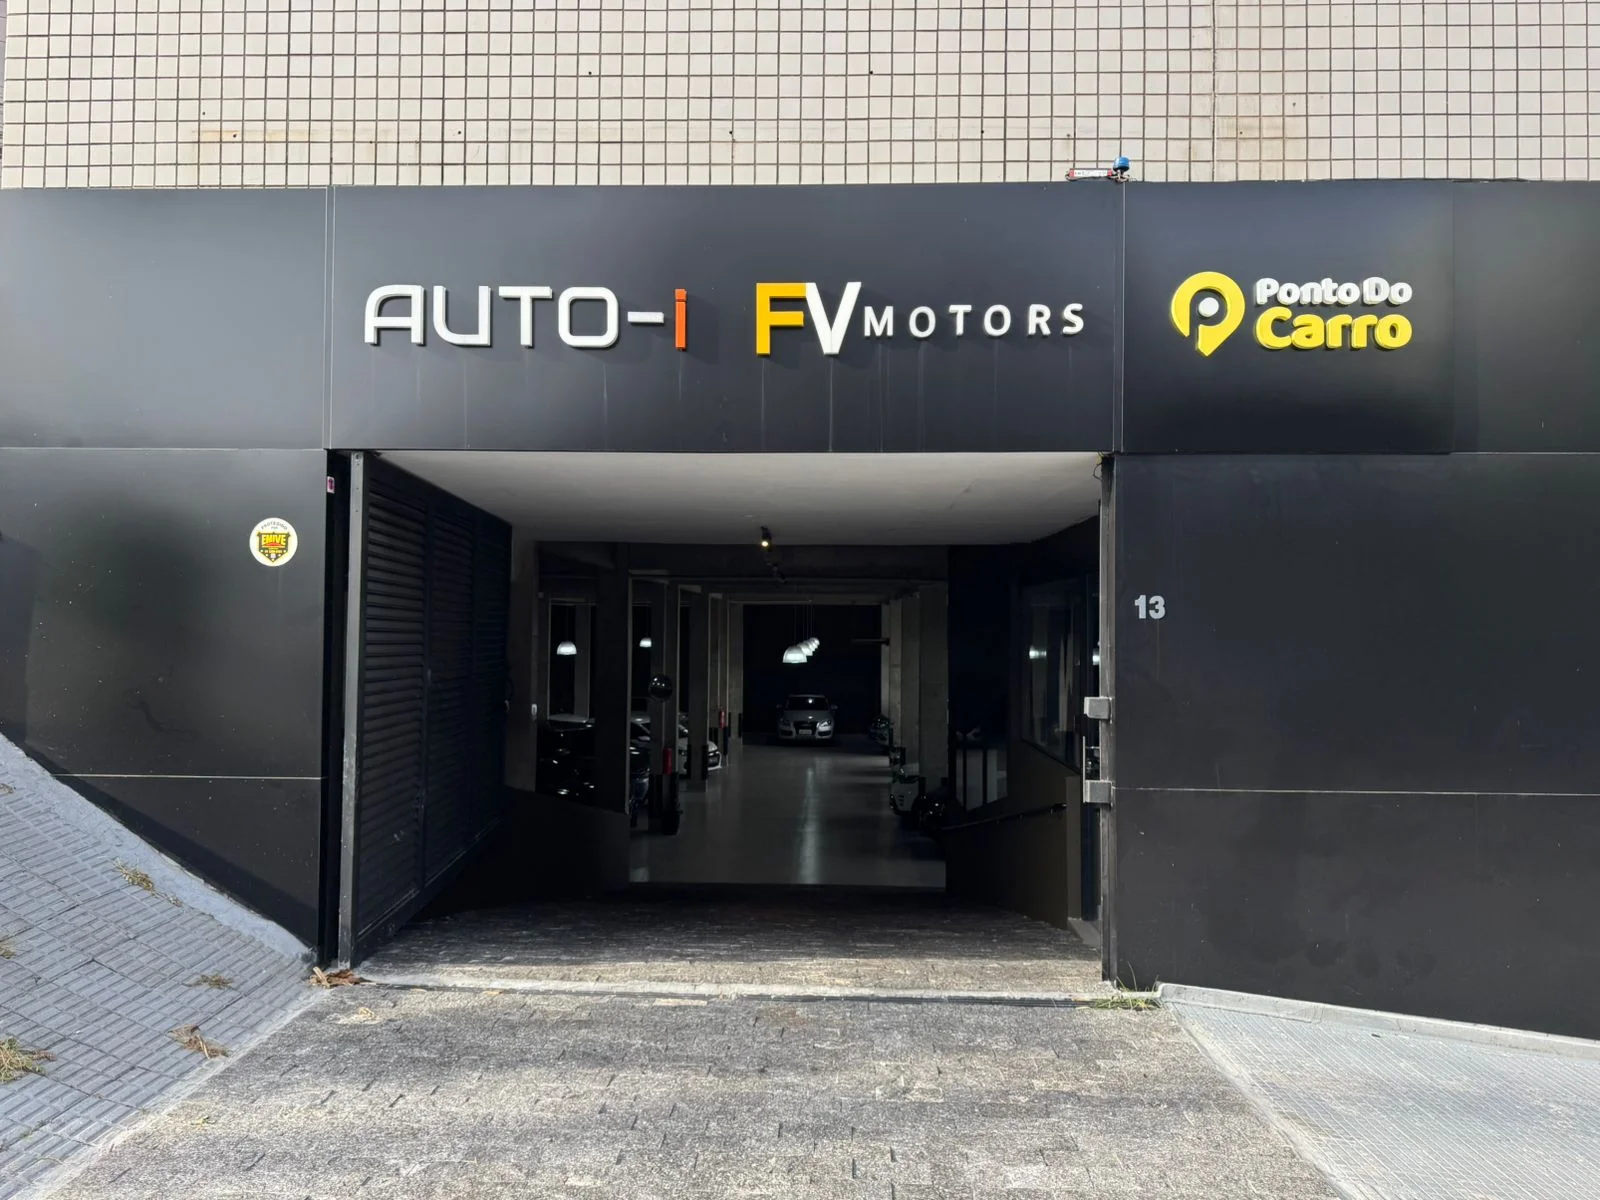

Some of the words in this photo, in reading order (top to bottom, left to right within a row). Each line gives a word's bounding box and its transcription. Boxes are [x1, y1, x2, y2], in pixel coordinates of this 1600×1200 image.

[755, 281, 862, 356] FV
[863, 302, 1085, 340] MOTORS
[1254, 306, 1414, 351] Carro
[1134, 594, 1166, 620] 13
